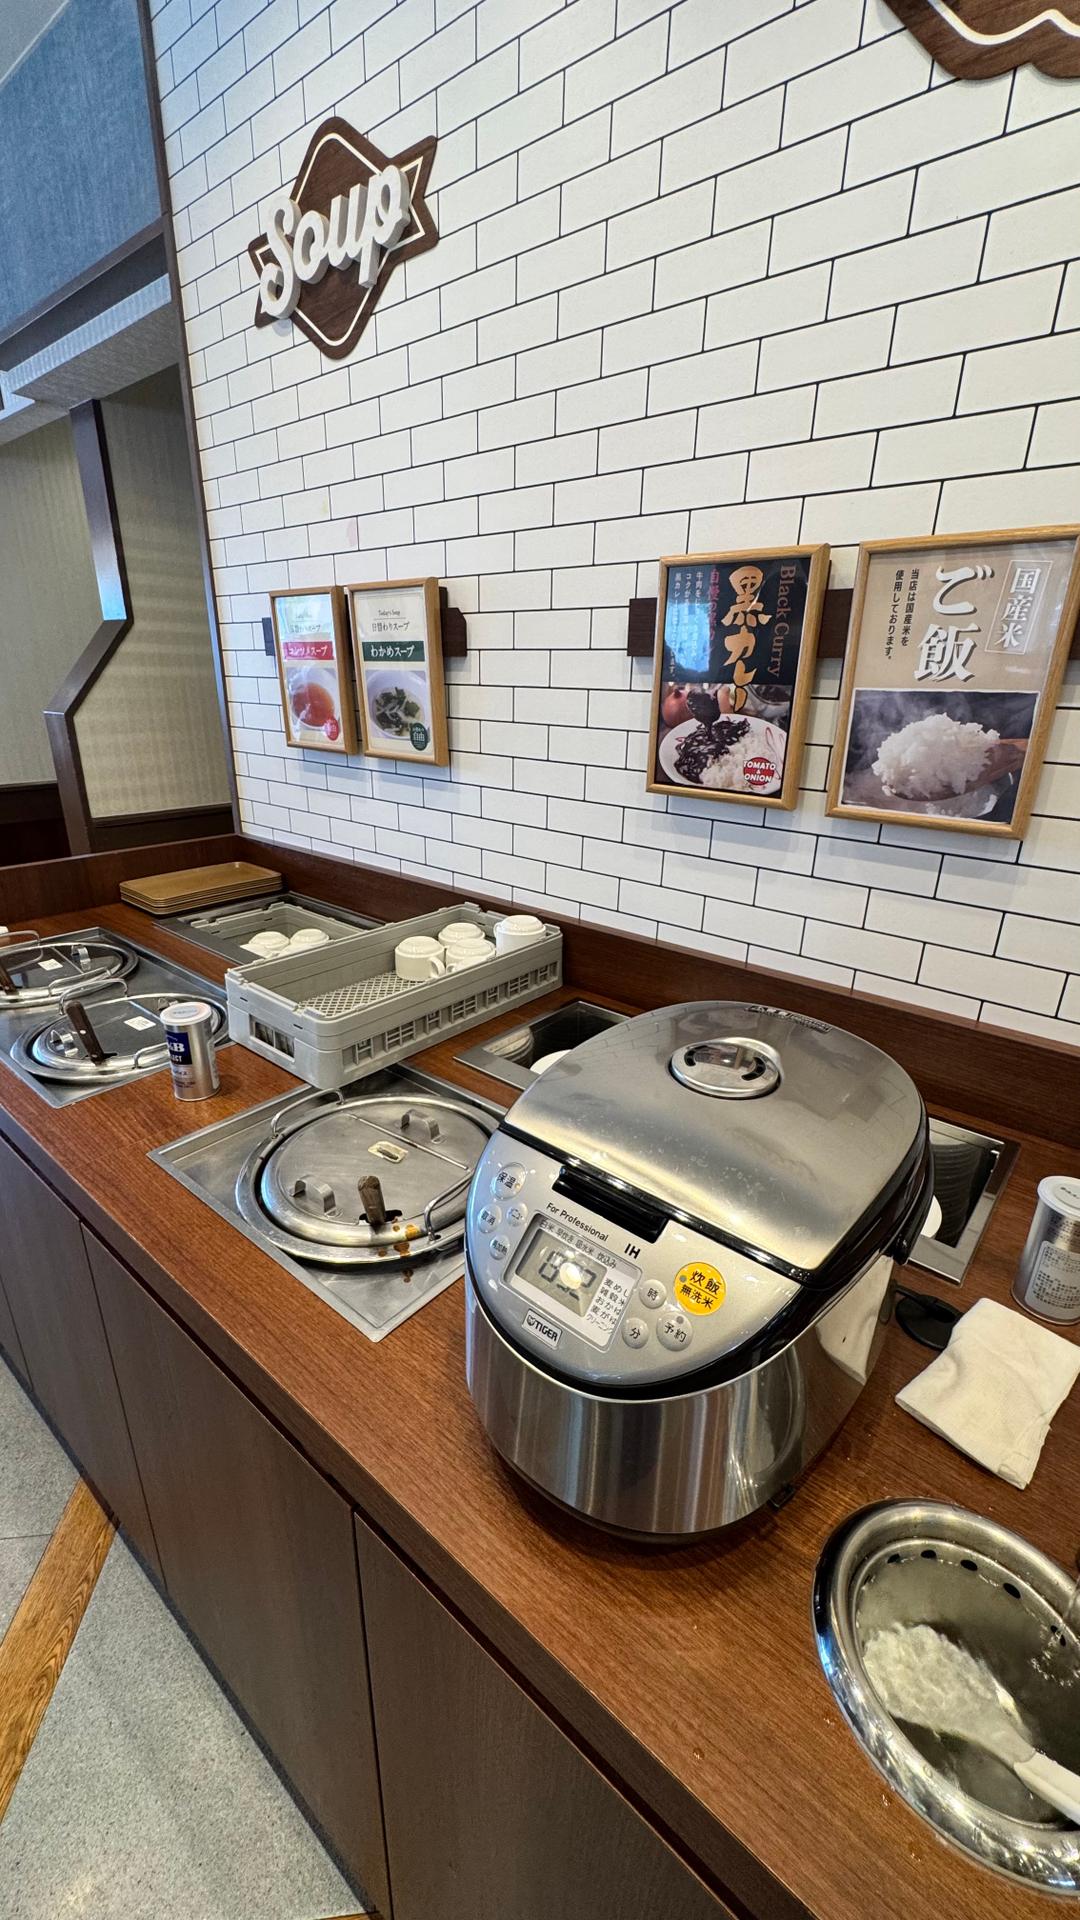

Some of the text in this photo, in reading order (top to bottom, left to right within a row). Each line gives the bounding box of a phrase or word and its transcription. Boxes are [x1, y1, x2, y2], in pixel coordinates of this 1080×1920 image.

[259, 164, 411, 320] Soup
[884, 569, 905, 660] 使用しております。
[901, 568, 920, 647] 当店は国産米を
[995, 567, 1042, 649] 国産米
[371, 621, 410, 632] 日替わりスープ
[767, 565, 796, 678] Black Curry
[914, 565, 995, 683] ご飯
[720, 565, 773, 713] 黒カレー
[288, 644, 329, 658] コンソメスープ
[370, 644, 416, 658] わかめスープ
[743, 760, 776, 770] TOMATO
[744, 773, 772, 782] ONION
[496, 1171, 516, 1189] 保温
[546, 1202, 609, 1243] For Professional
[624, 1243, 641, 1259] IH
[646, 1287, 659, 1301] 時
[689, 1270, 722, 1296] 炊飯
[680, 1284, 714, 1310] 無洗米
[534, 1319, 559, 1342] TIGER
[629, 1327, 641, 1340] 分
[664, 1321, 687, 1343] 予約
